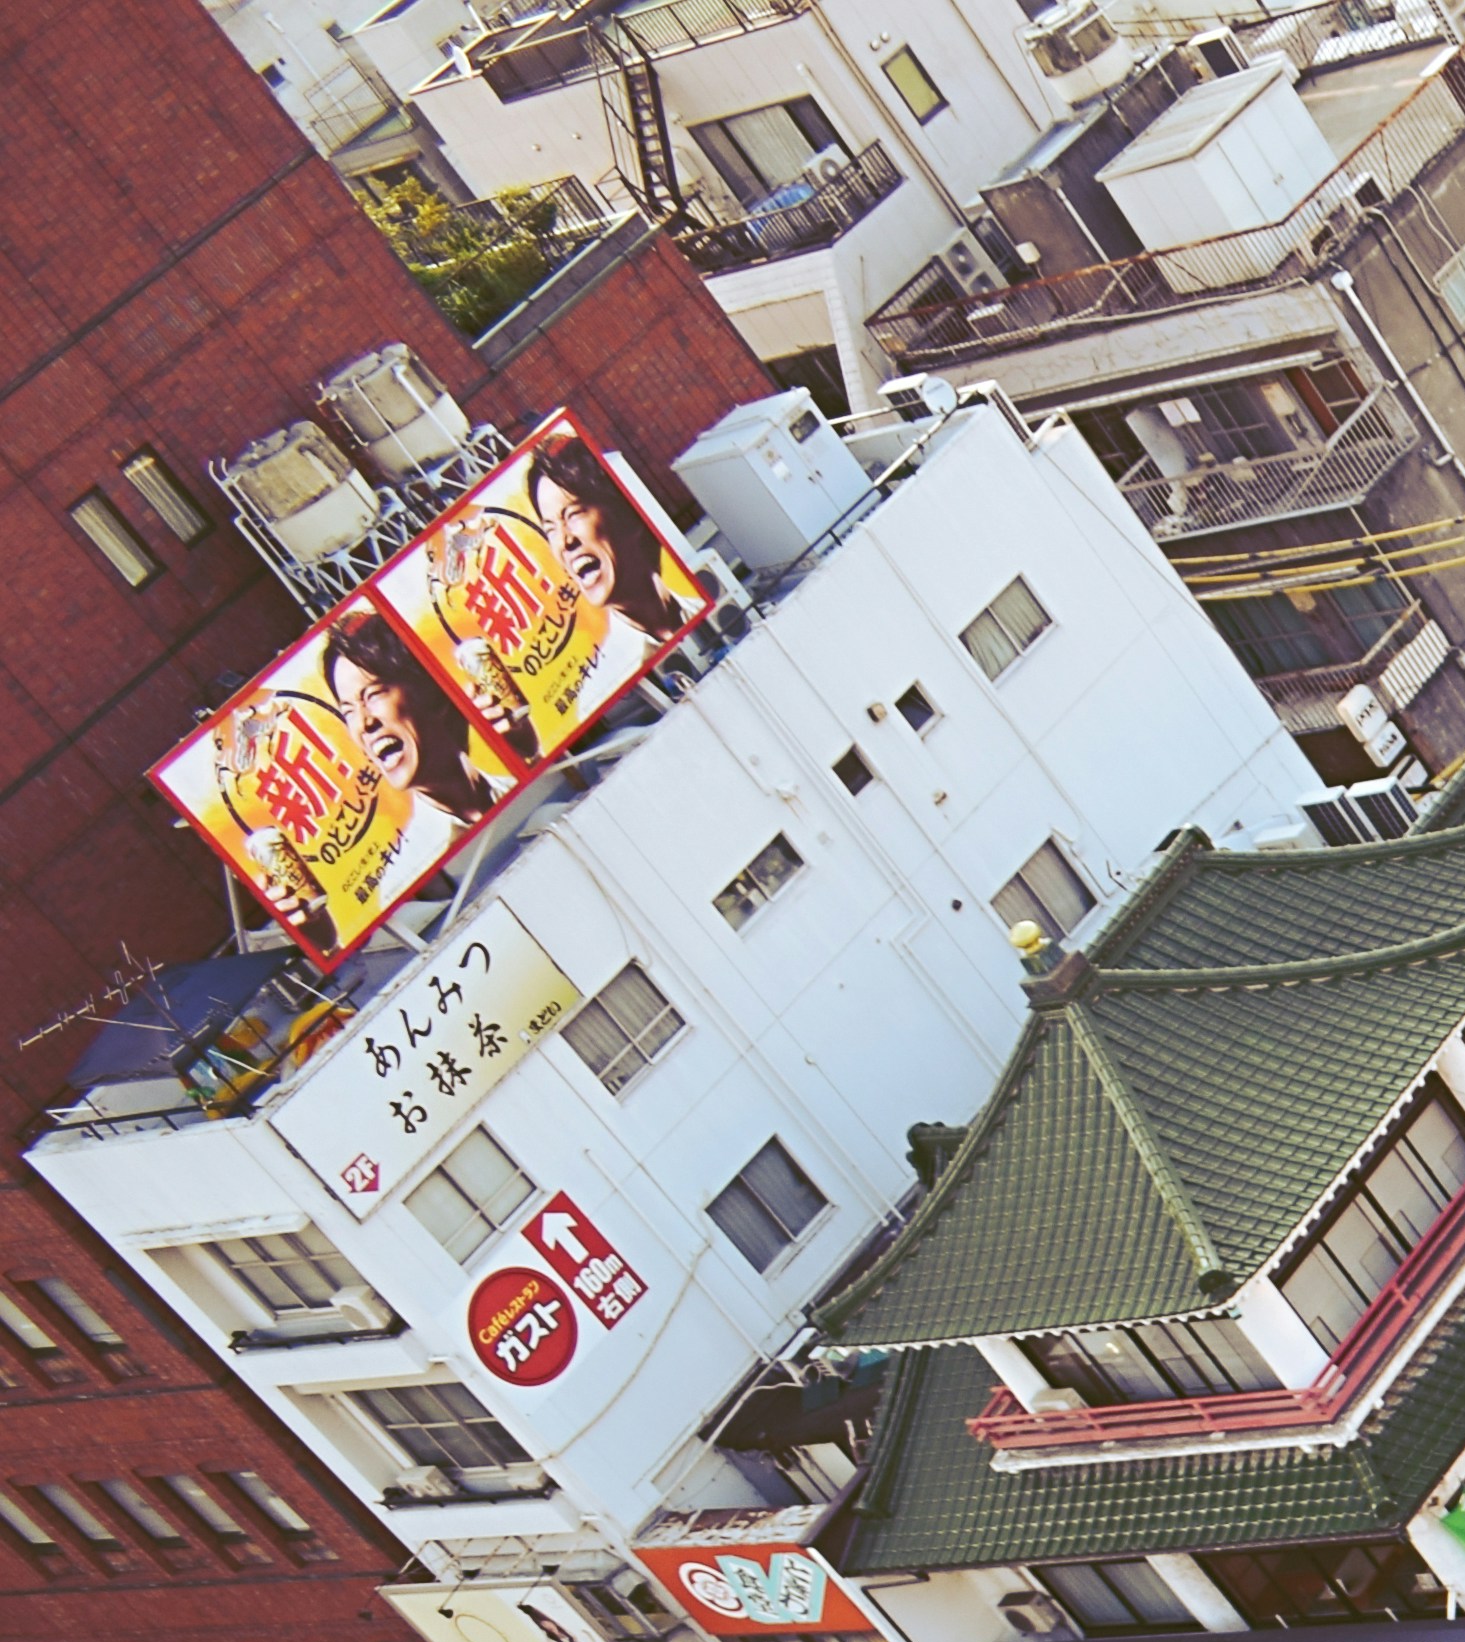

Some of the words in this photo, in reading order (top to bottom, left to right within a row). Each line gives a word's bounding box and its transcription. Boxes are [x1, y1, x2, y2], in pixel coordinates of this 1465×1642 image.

[365, 942, 491, 1078] あんみつ
[389, 1012, 508, 1134] お抹茶
[345, 1156, 378, 1192] 2F
[573, 1253, 624, 1299] 160m
[596, 1271, 643, 1320] 右側
[495, 1298, 562, 1373] ガスト
